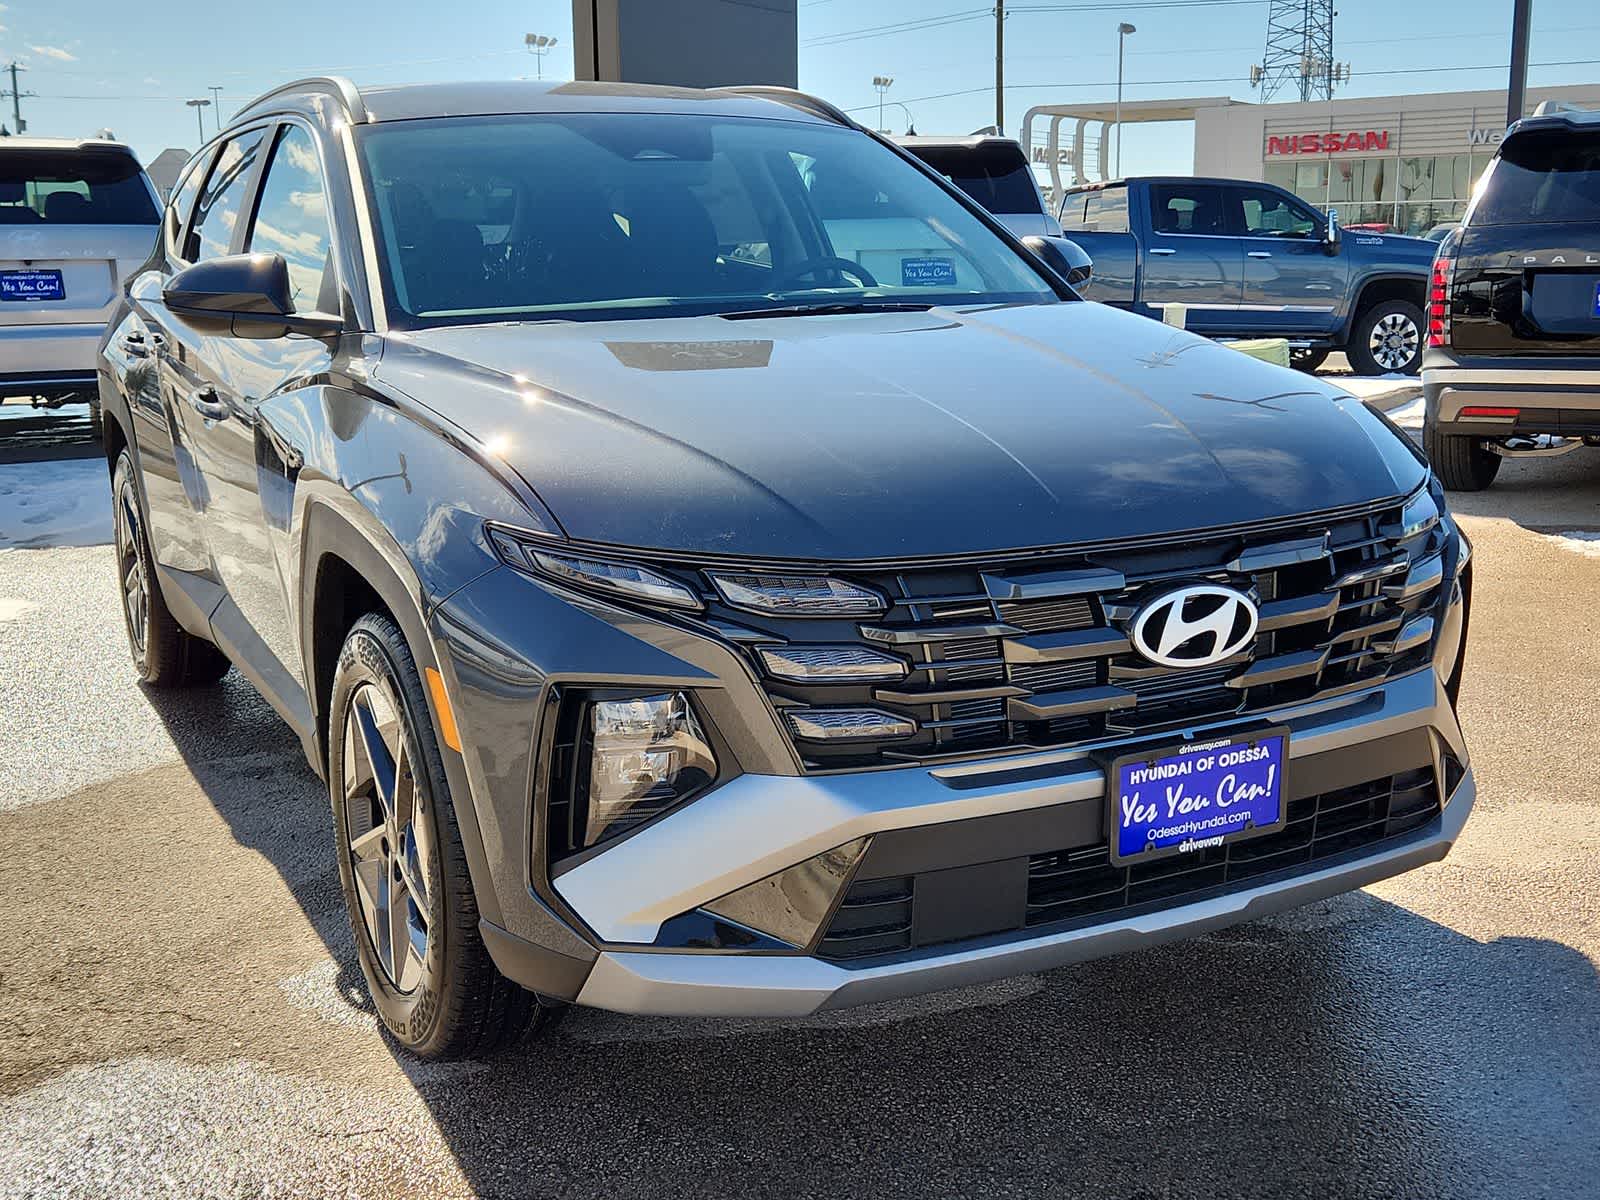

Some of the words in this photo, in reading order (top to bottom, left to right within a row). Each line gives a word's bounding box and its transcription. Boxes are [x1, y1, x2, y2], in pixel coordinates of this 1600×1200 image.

[1268, 131, 1389, 155] NISSAN
[2, 281, 15, 292] Yes
[18, 281, 35, 291] You
[36, 280, 59, 291] Can!
[1178, 738, 1231, 755] driveway.com
[1130, 761, 1192, 785] HYUNDAI
[1196, 756, 1215, 772] OF
[1218, 746, 1269, 768] ODESSA
[1121, 791, 1158, 827] Yes
[1166, 783, 1210, 818] You
[1216, 763, 1276, 808] Can!
[1147, 810, 1251, 840] OdessaHyundai.com
[1178, 834, 1224, 853] driveway
